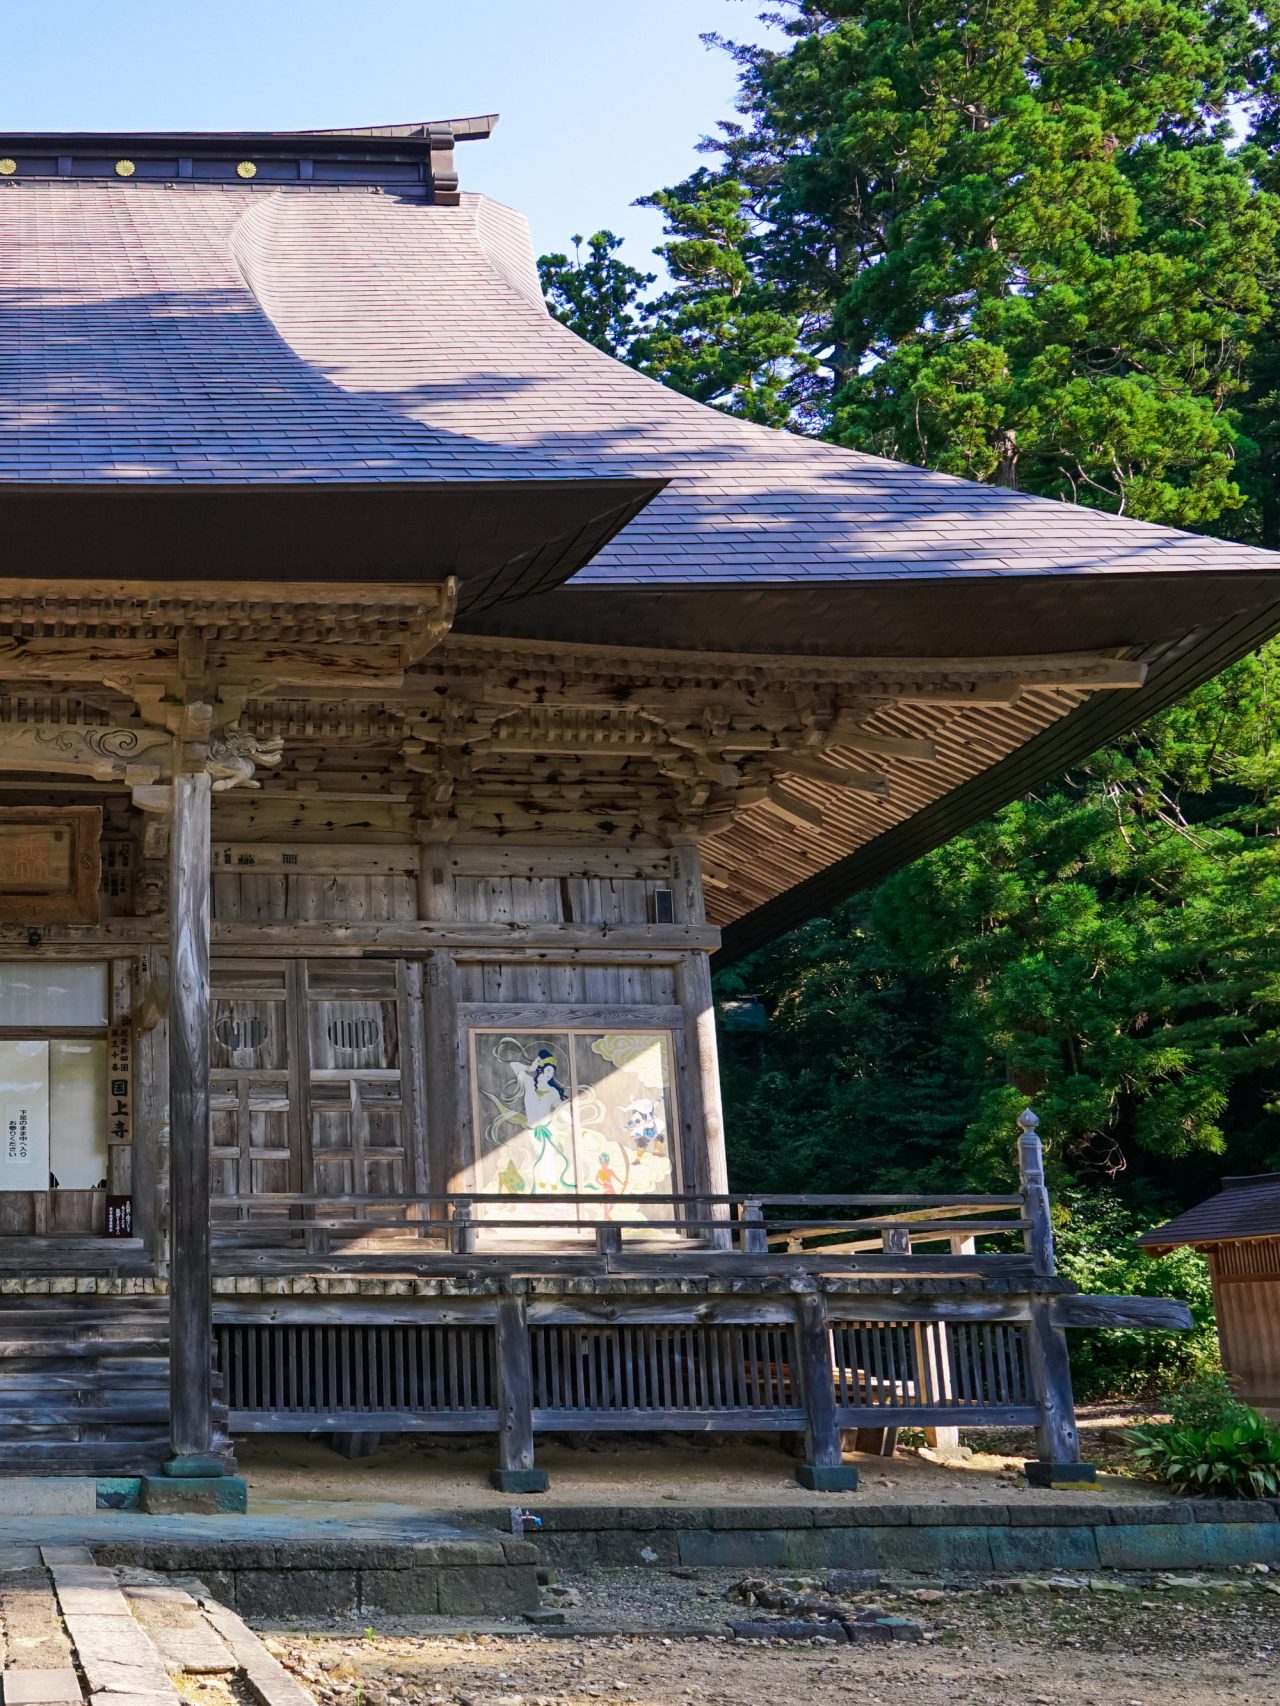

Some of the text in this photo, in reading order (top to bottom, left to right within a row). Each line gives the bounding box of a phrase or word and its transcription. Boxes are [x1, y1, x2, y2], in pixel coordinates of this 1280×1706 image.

[19, 1109, 28, 1158] 下足のまま中へ入り
[111, 1079, 129, 1139] 国上寺
[8, 1120, 17, 1158] おりください
